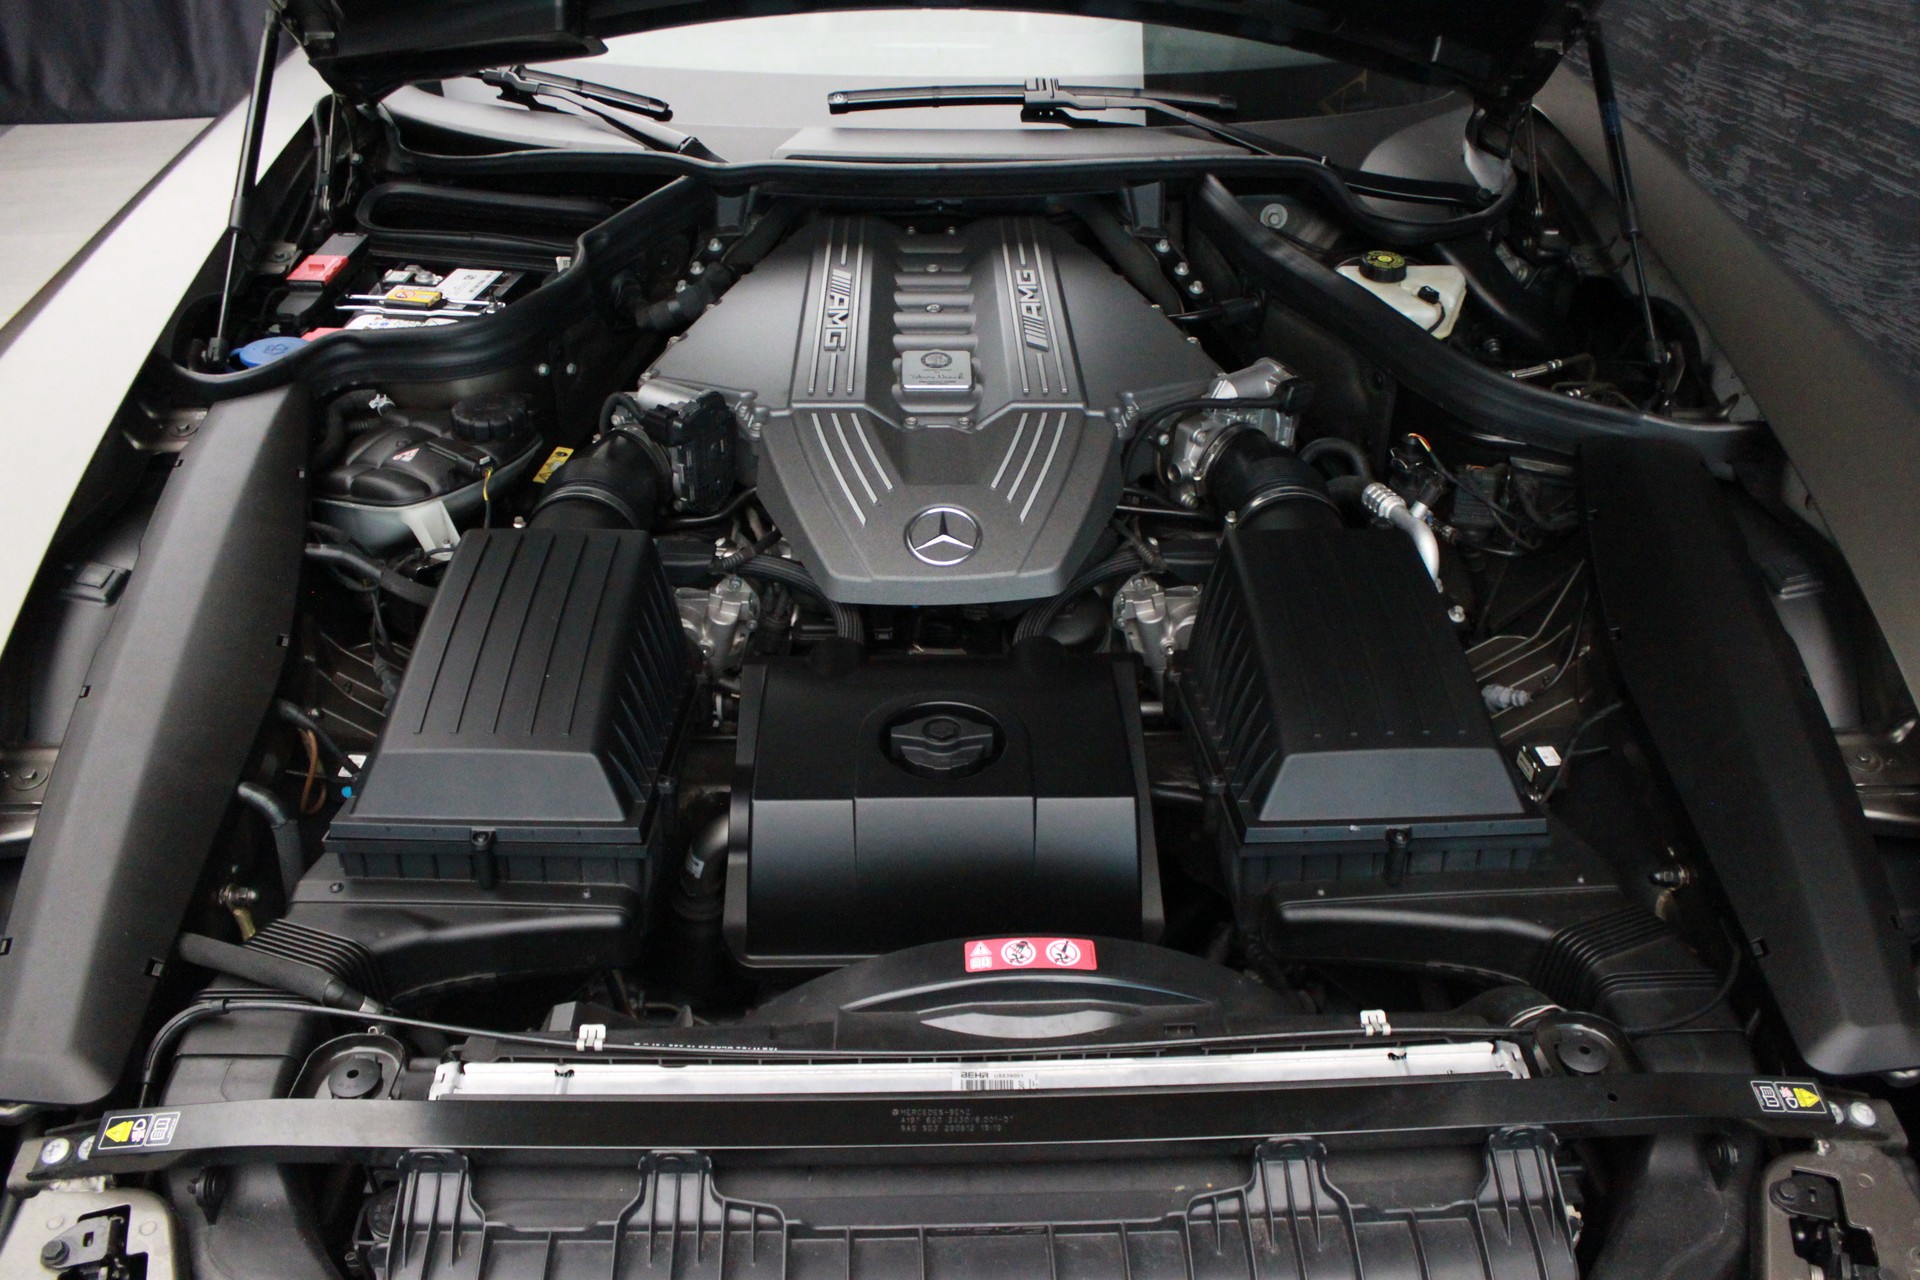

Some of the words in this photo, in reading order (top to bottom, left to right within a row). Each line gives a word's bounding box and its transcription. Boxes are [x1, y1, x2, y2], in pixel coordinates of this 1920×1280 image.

[1015, 269, 1043, 321] AMG
[824, 294, 850, 351] AMG
[960, 1071, 989, 1079] BEHR
[900, 1108, 971, 1116] MERCEDES-BENZ
